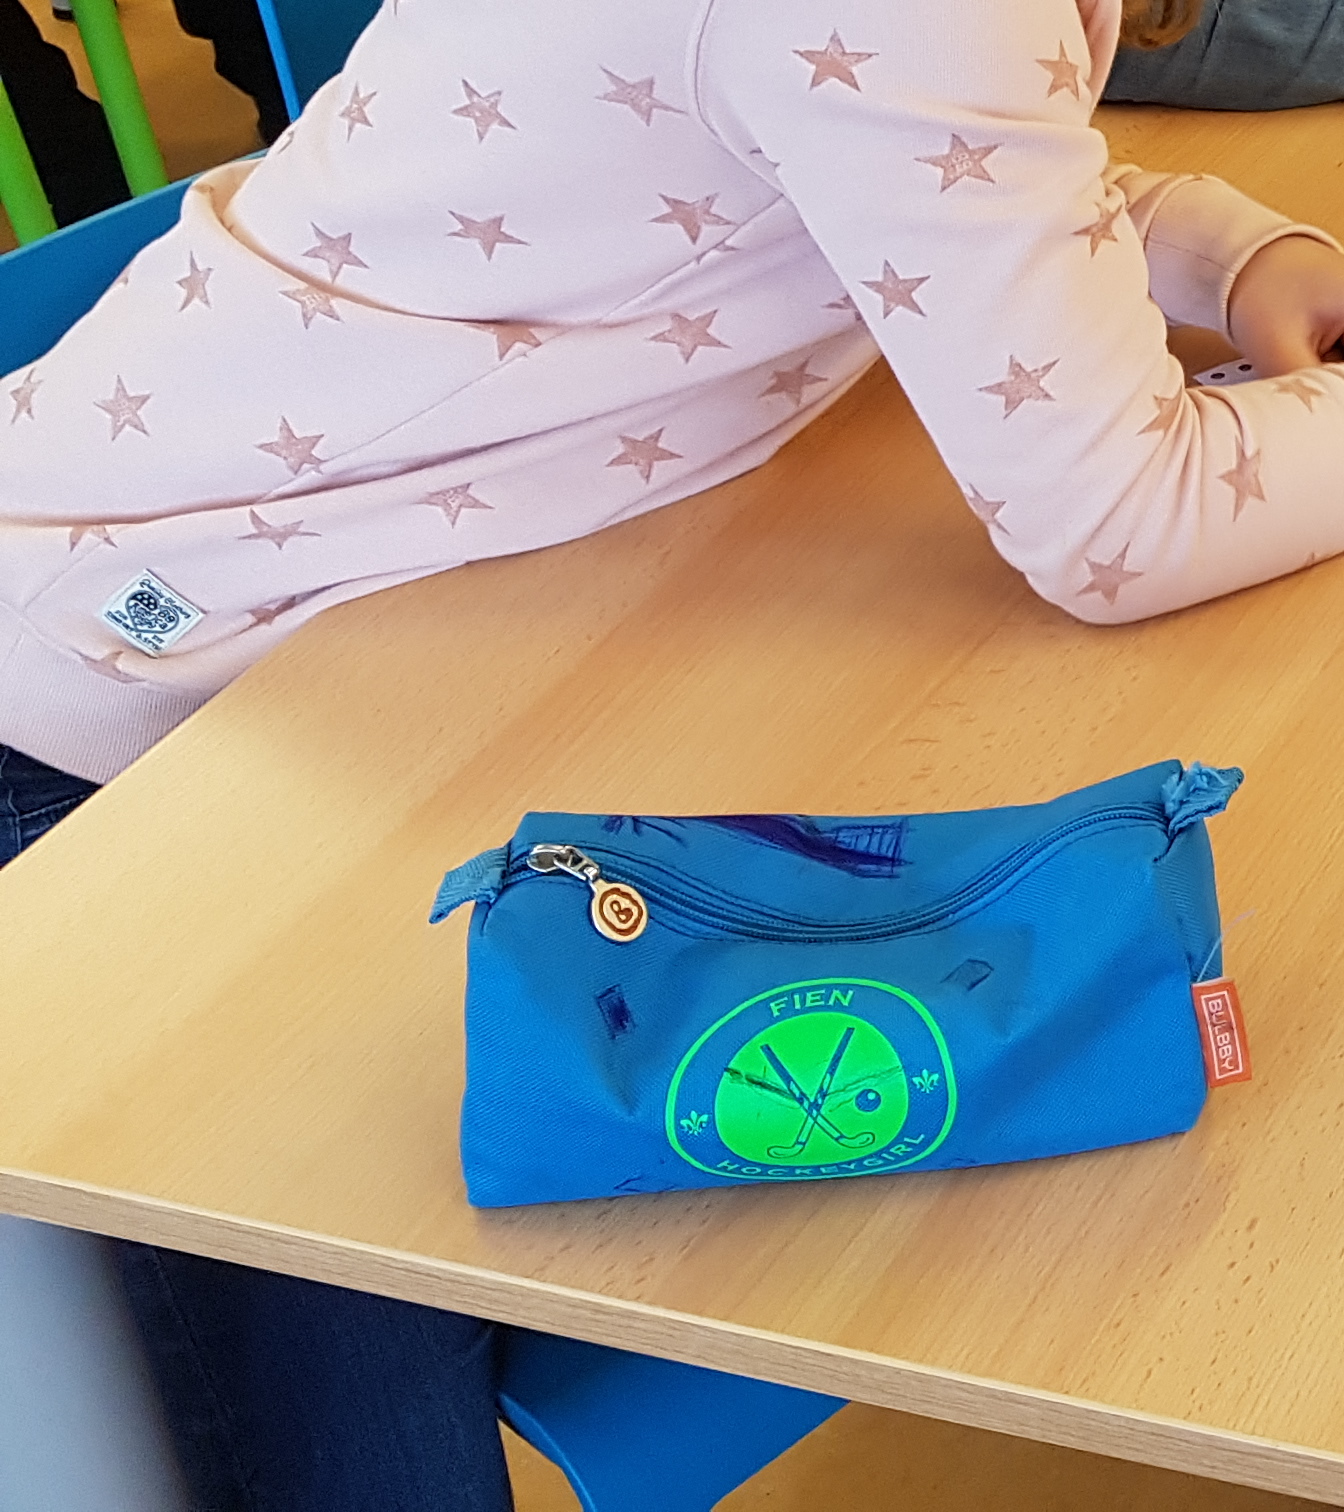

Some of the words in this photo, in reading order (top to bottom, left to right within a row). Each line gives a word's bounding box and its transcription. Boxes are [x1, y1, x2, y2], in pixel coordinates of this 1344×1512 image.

[769, 989, 855, 1018] FIEN
[1208, 998, 1235, 1070] BULBBY
[716, 1132, 926, 1177] HOCKEYGIRL
